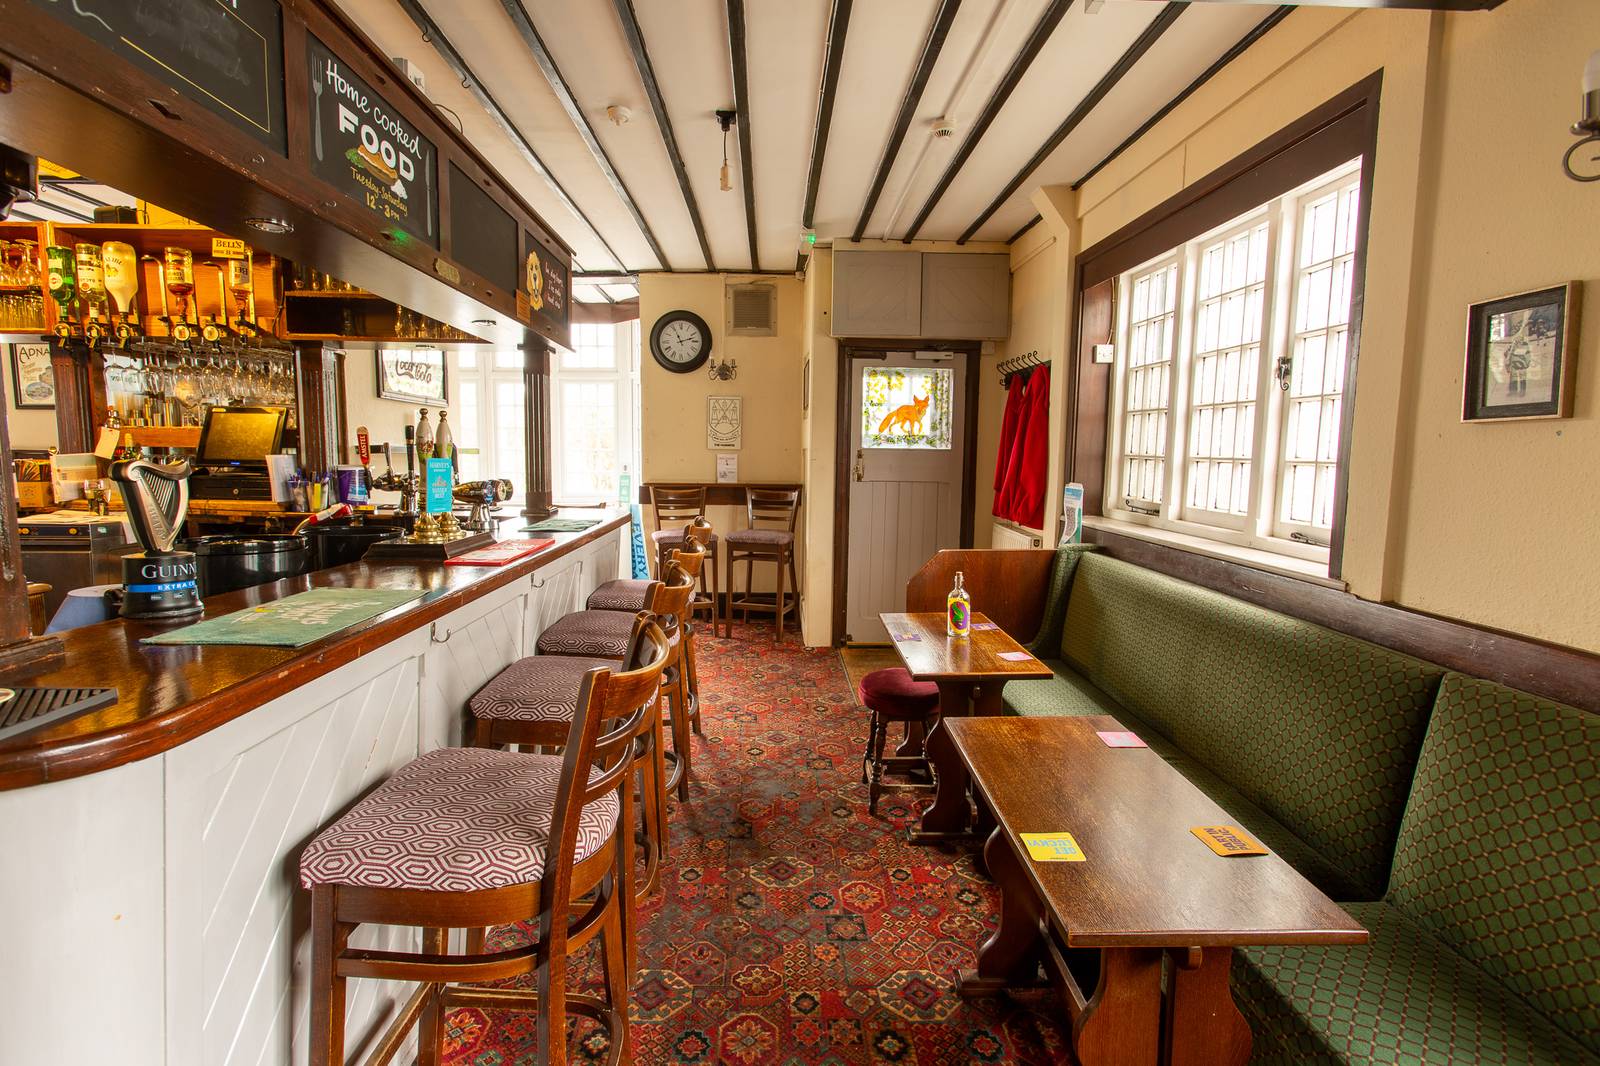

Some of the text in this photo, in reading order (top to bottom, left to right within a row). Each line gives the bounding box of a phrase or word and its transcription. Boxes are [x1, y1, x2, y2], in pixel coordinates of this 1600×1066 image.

[326, 58, 422, 159] Home cooked
[338, 102, 415, 182] FOOD
[365, 192, 377, 210] 12
[215, 239, 243, 249] BELL'S
[19, 346, 52, 364] ADNA
[360, 435, 368, 458] AMSTEL
[633, 522, 648, 577] EVERY
[141, 561, 197, 579] GUINN
[157, 582, 187, 591] EXTRA
[1055, 847, 1077, 855] GET
